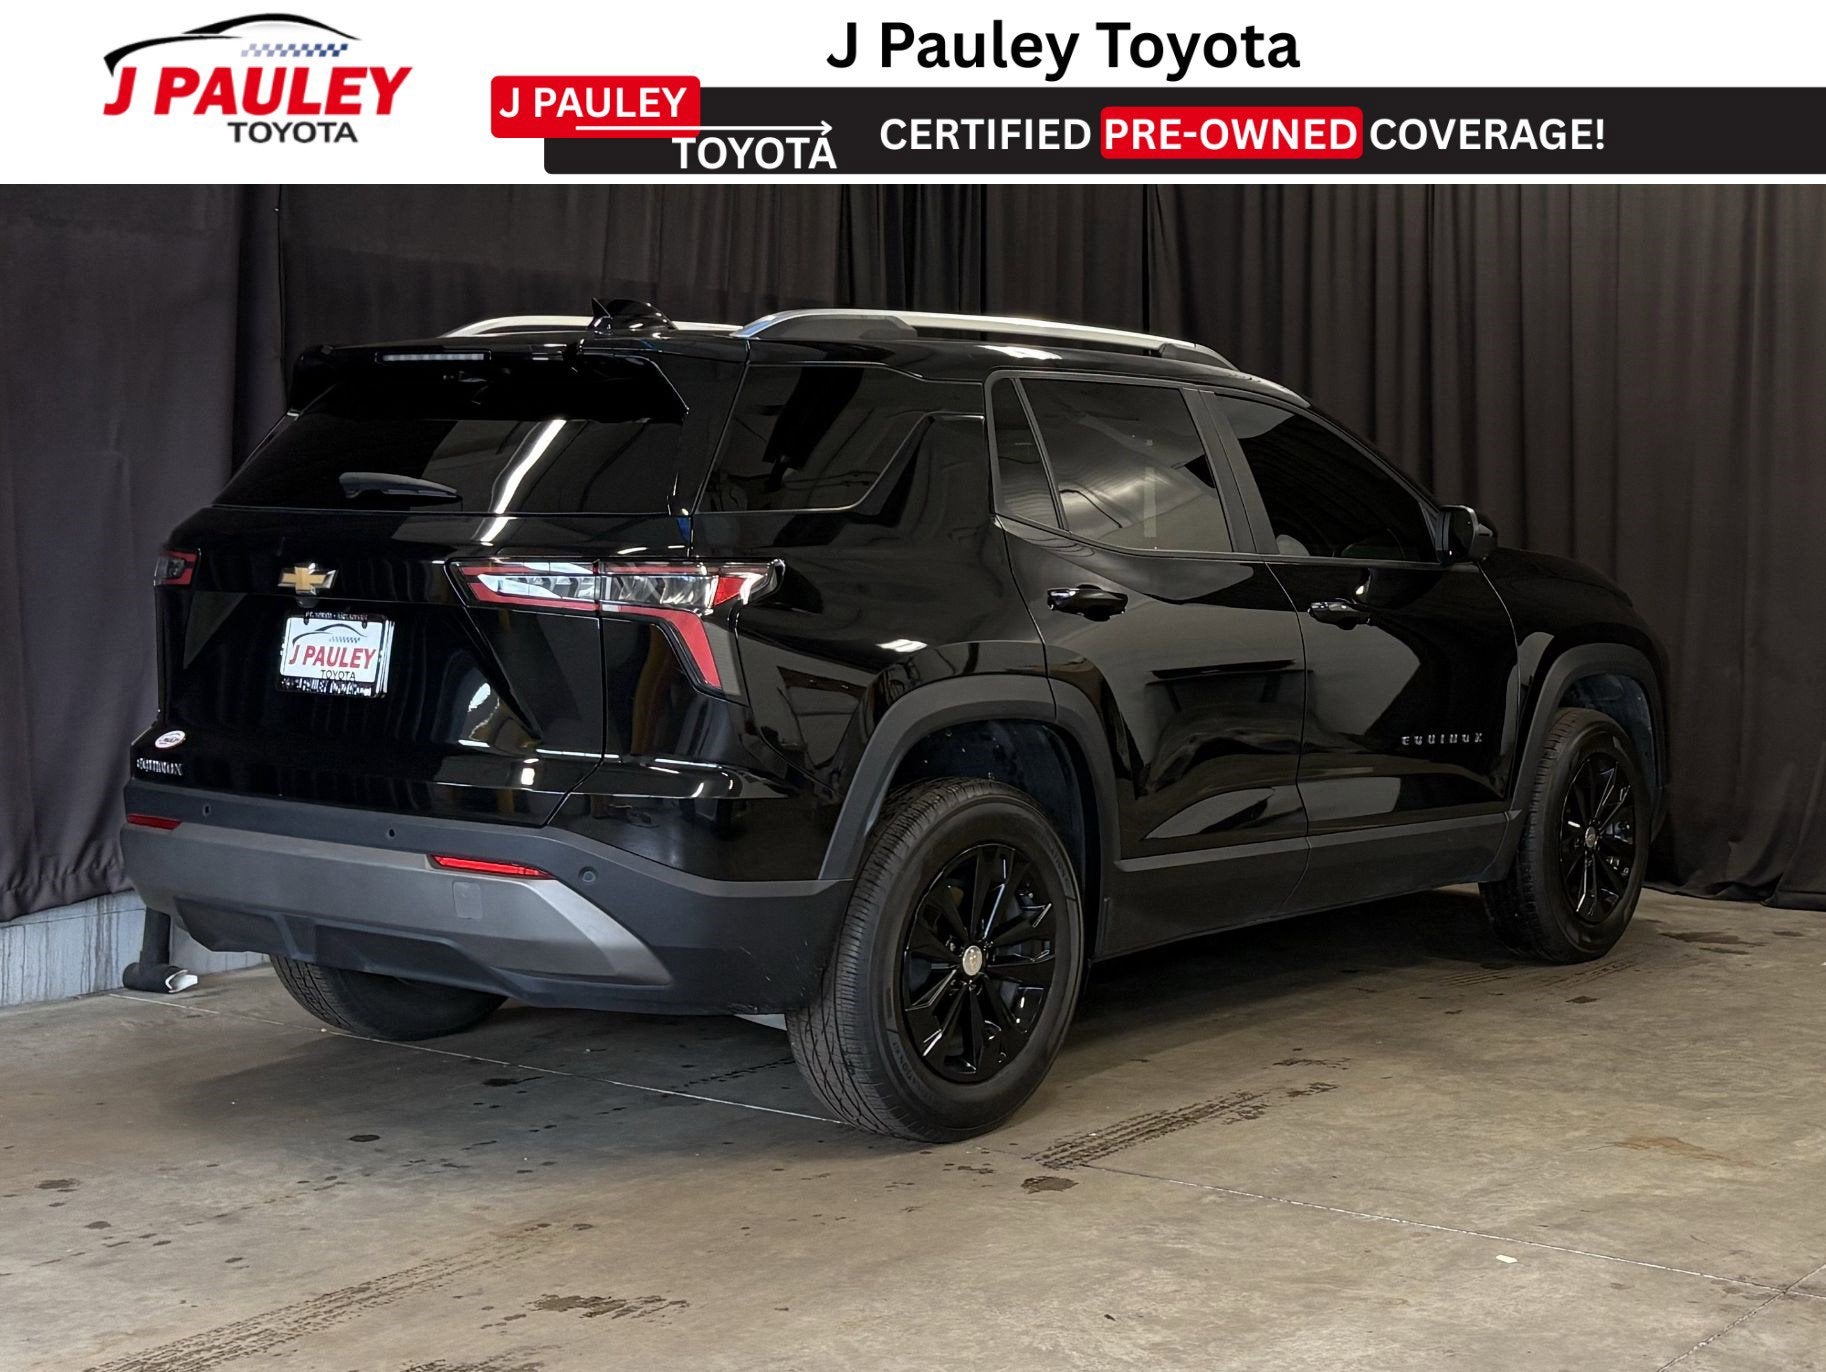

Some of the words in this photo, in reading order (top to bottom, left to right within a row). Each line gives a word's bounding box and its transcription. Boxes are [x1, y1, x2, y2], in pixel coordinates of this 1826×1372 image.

[288, 644, 300, 665] J
[302, 645, 376, 670] PAULEY
[321, 669, 356, 680] TOYOTA
